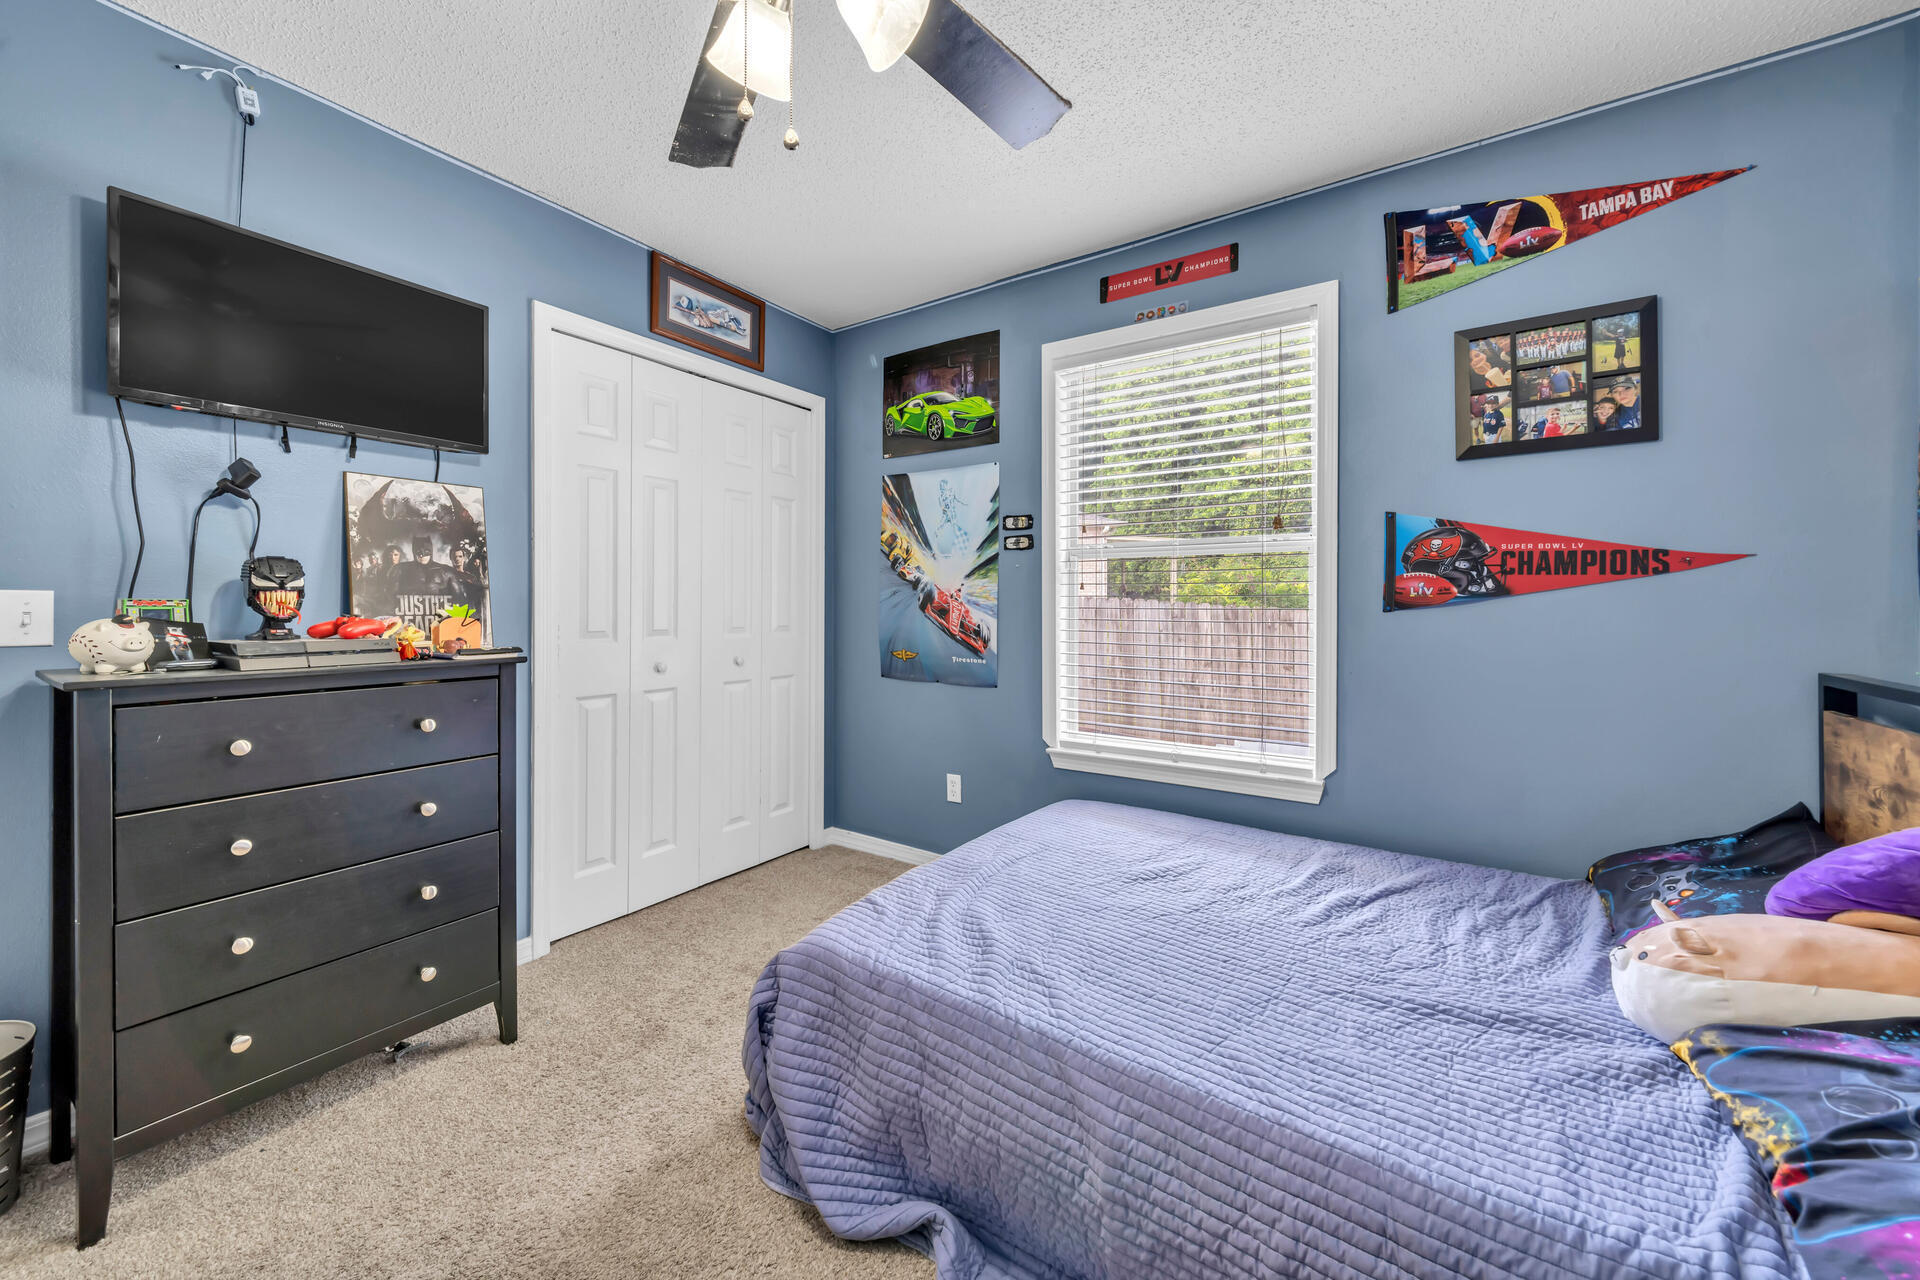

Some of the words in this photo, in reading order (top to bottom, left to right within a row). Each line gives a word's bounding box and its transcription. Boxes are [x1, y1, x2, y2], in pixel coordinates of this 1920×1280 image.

[1579, 191, 1638, 221] TAMPA
[1640, 180, 1674, 205] BAY
[1108, 281, 1131, 292] SUPER
[1133, 276, 1153, 286] BOWL
[1184, 256, 1229, 273] CHAMPIONS
[317, 421, 345, 429] INSIGNIA
[1500, 549, 1670, 576] CHAMPIONS
[951, 656, 987, 665] Firestone
